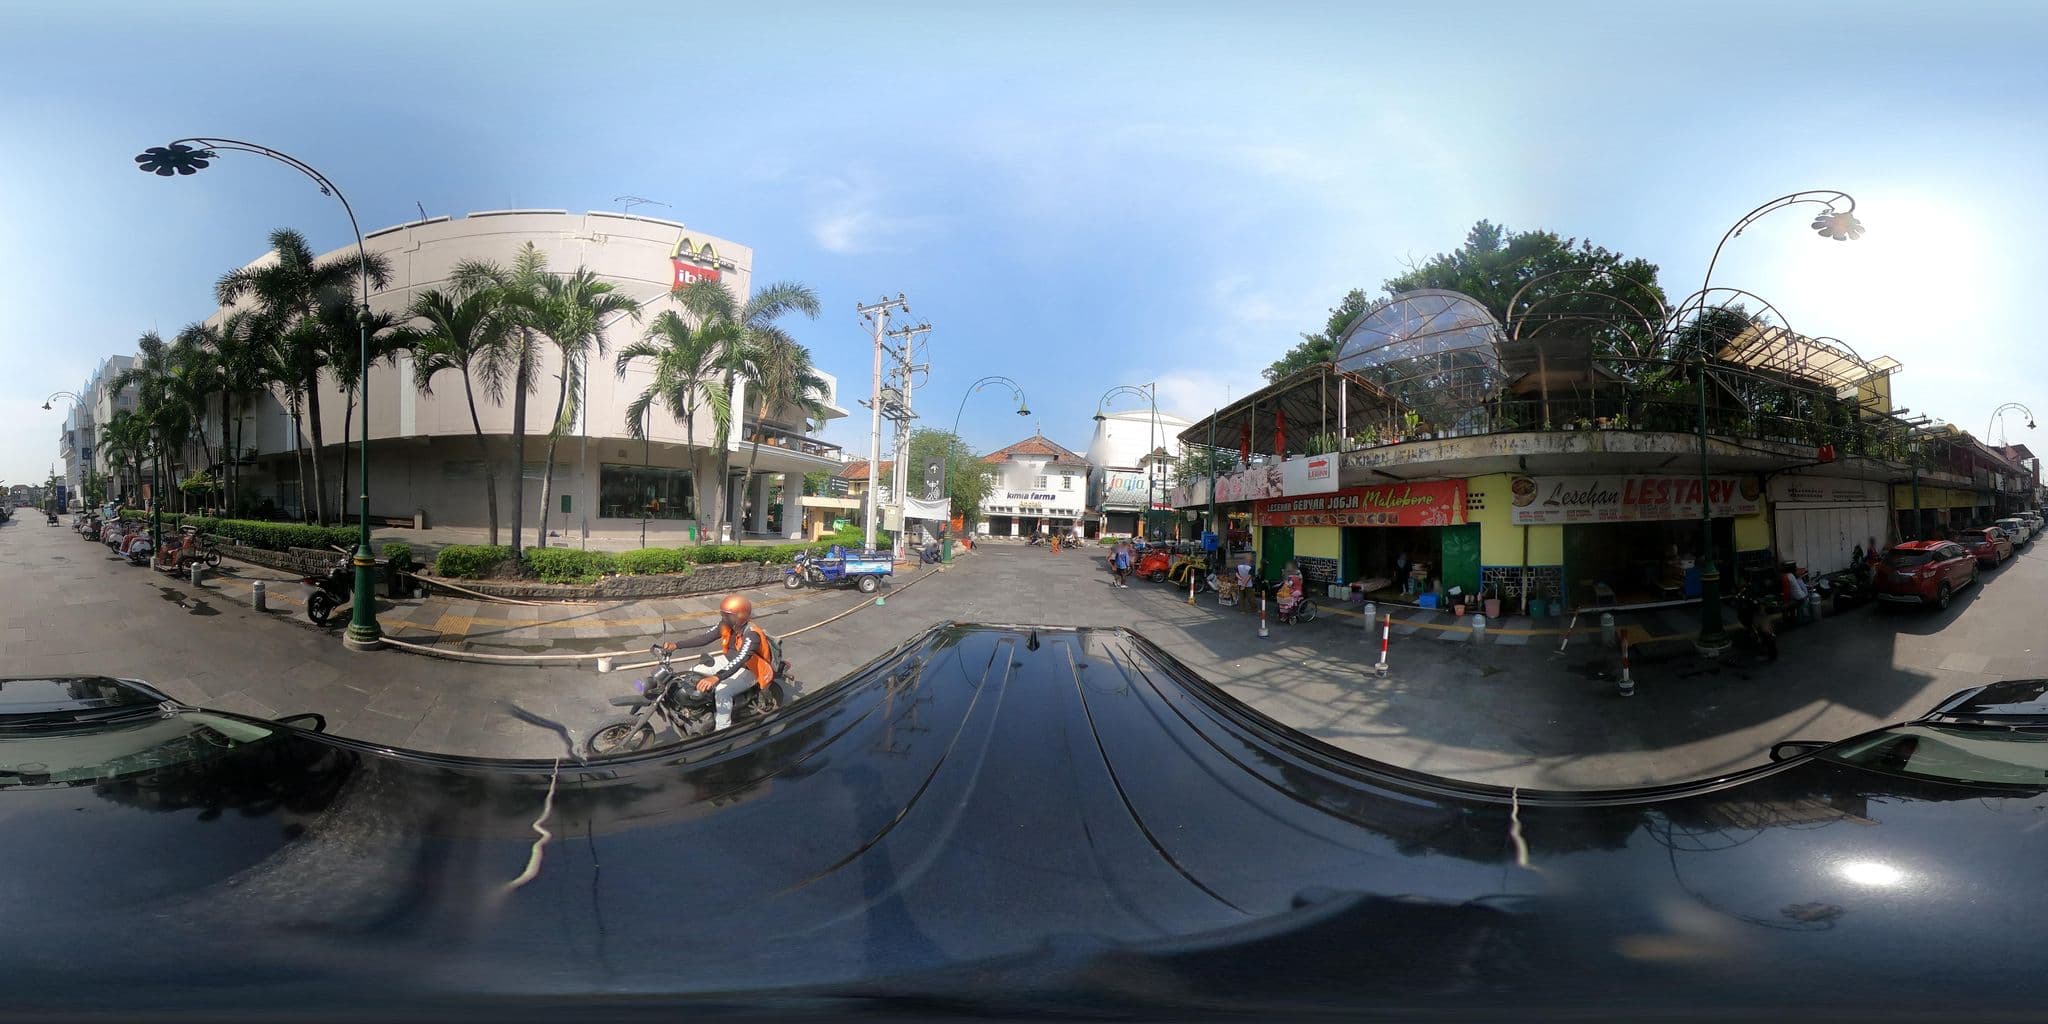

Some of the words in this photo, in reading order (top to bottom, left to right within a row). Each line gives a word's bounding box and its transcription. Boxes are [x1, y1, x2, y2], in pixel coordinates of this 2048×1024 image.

[1108, 474, 1145, 491] jogja
[1006, 492, 1029, 500] kimia
[1030, 492, 1056, 500] farma
[1543, 481, 1618, 507] Lesehan
[1623, 479, 1736, 505] LESTARY
[1293, 498, 1325, 510] GEBYAR
[1328, 496, 1358, 509] JOGJA
